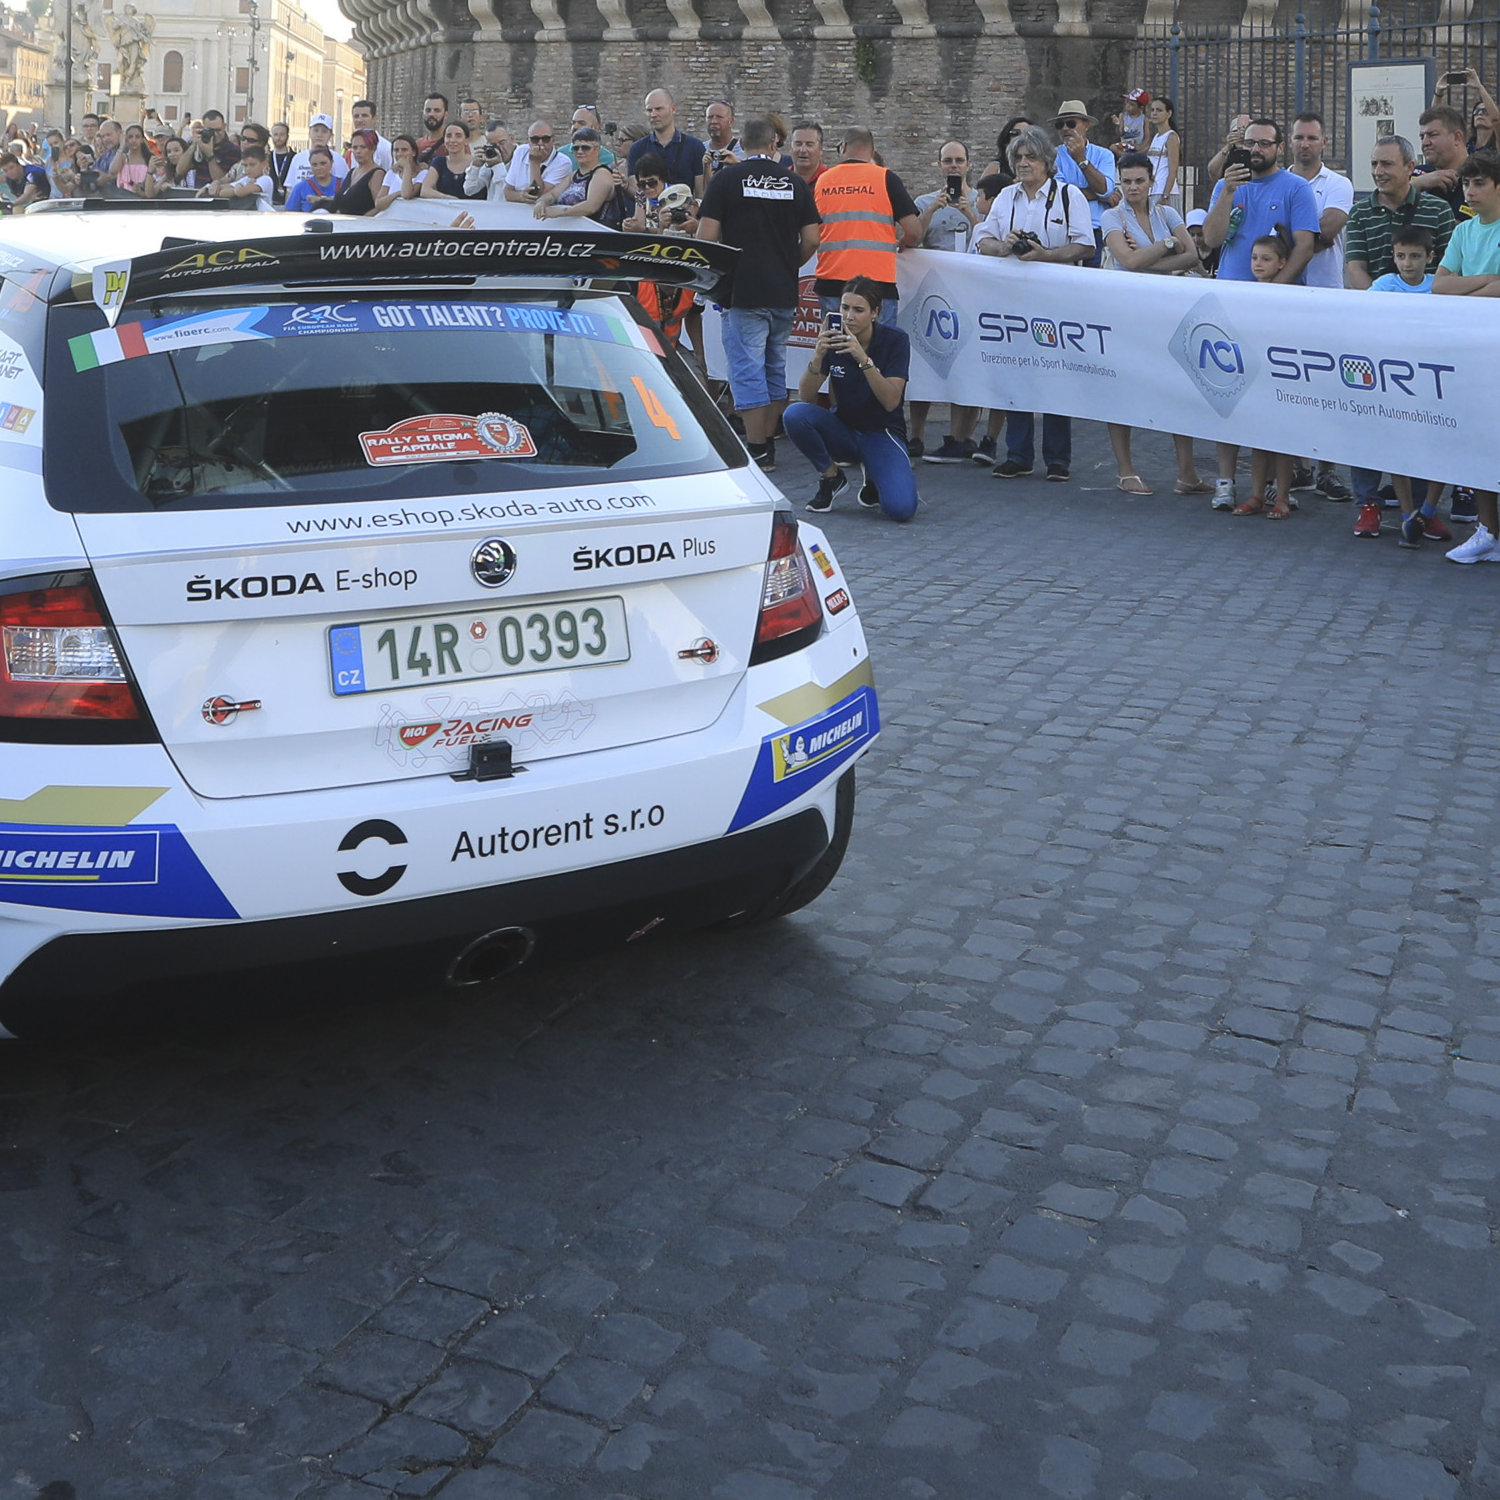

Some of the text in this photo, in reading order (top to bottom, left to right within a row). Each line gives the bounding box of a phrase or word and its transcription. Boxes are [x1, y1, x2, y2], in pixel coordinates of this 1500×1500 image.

[821, 185, 876, 196] MARSHAL
[164, 247, 277, 273] ACA
[318, 235, 597, 261] www.autocentrala.cz
[624, 243, 710, 263] ACA
[152, 325, 231, 343] www.fiaerc.com
[298, 327, 360, 335] CHAMPIONSHIP
[371, 304, 598, 337] GOT TALENT? PROVE IT!
[925, 308, 960, 341] ACI
[978, 312, 1113, 355] SPORT
[981, 351, 1117, 378] Direzione per lo Sport Automobilistico
[1199, 338, 1245, 375] ACI
[1266, 346, 1455, 400] SPORT
[630, 376, 683, 441] 4
[1275, 388, 1457, 429] Direzione per lo Sport Automobilistico
[366, 432, 474, 447] RALLY DI ROMA
[390, 441, 457, 454] CAPITALE
[286, 491, 658, 536] www.eshop.skoda-auto.com
[572, 536, 717, 572] ŠKODA Plus
[186, 568, 419, 602] ŠKODA E-shop
[377, 623, 463, 681] 14R
[498, 606, 608, 667] 0393
[337, 669, 362, 687] CZ
[403, 726, 429, 739] MOL
[441, 713, 534, 738] RACING
[808, 711, 864, 755] MICHELIN
[450, 804, 666, 864] Autorent s.r.o
